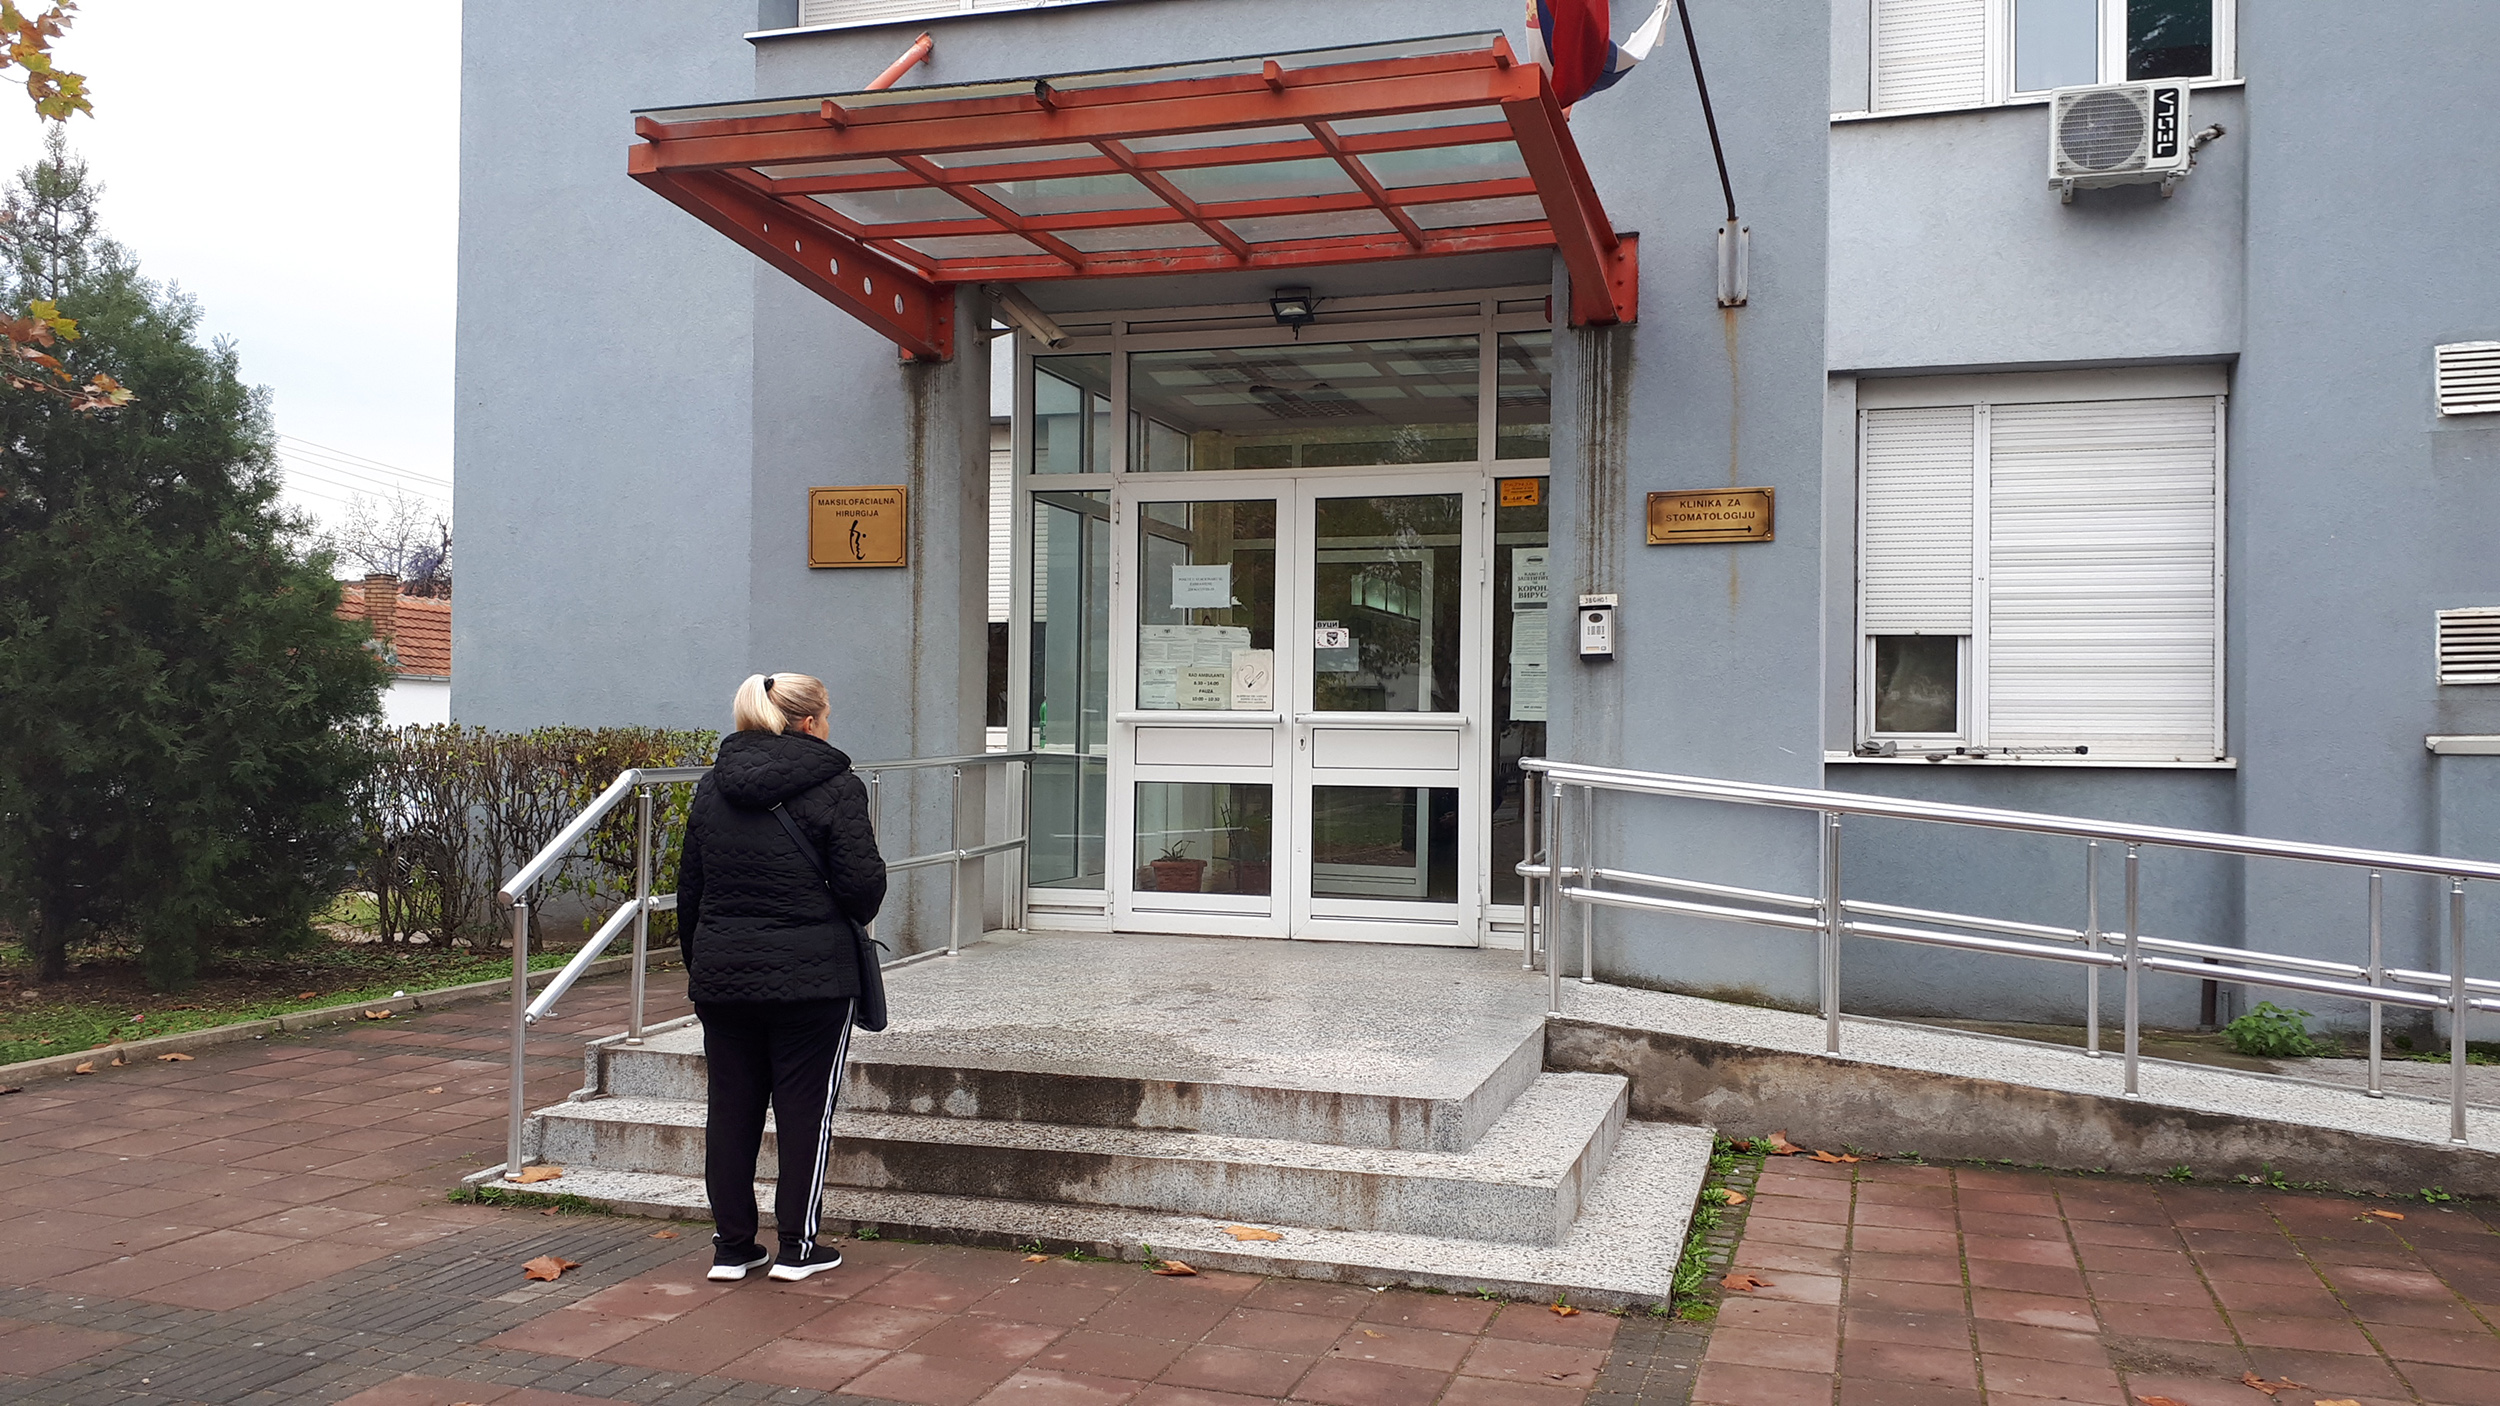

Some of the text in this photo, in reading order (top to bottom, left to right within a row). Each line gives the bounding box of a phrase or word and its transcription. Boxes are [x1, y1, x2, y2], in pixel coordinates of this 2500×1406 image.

[2157, 91, 2175, 155] TESLA
[818, 497, 895, 506] MAKSILOFACIALNA
[1679, 498, 1741, 509] KLINIKA ZA
[1665, 511, 1756, 522] STOMATOLOGIJU
[1518, 591, 1549, 599] ВИРУС
